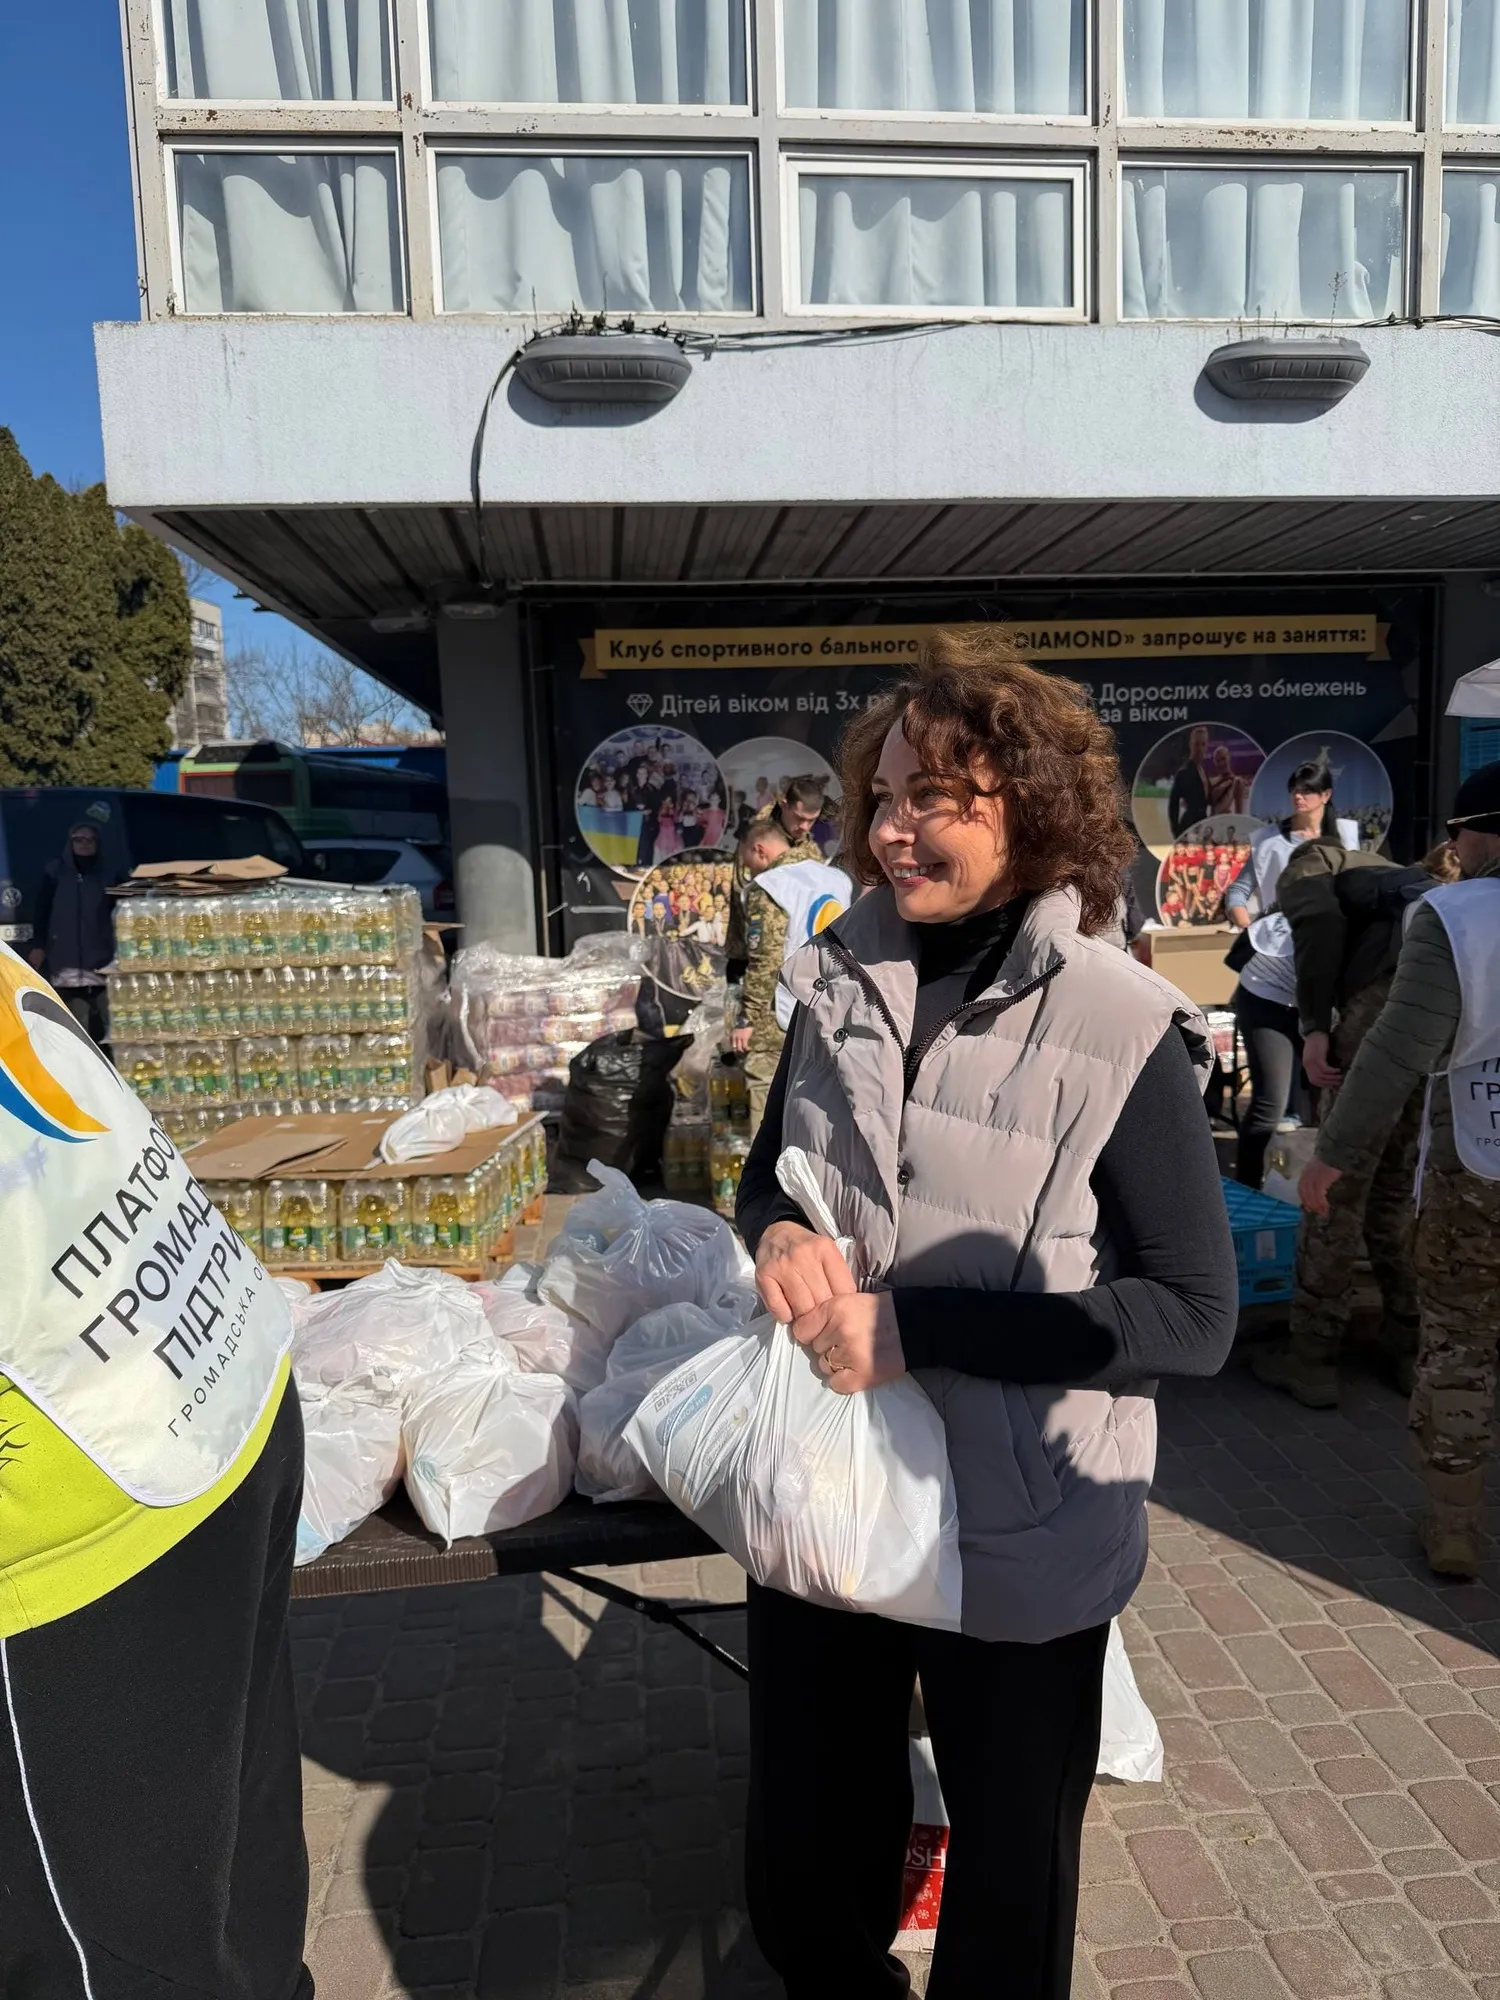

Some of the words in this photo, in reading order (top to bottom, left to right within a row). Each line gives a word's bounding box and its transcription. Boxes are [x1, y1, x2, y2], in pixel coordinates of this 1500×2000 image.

[609, 639, 665, 663] Клуб
[671, 641, 813, 662] спортивного
[820, 637, 920, 655] бального
[1142, 631, 1247, 649] запрошує
[1254, 630, 1276, 644] на
[1283, 628, 1367, 643] заняття:
[660, 694, 721, 717] Дітей
[728, 693, 790, 713] віком
[796, 692, 830, 715] від
[1099, 682, 1210, 706] Дорослих
[1216, 679, 1253, 699] без
[1259, 678, 1367, 699] обмежень
[1100, 709, 1122, 723] за
[1129, 703, 1188, 722] віком
[51, 1115, 175, 1299] ПЛАТФО
[167, 1286, 257, 1438] ГРОМАДСЬКА
